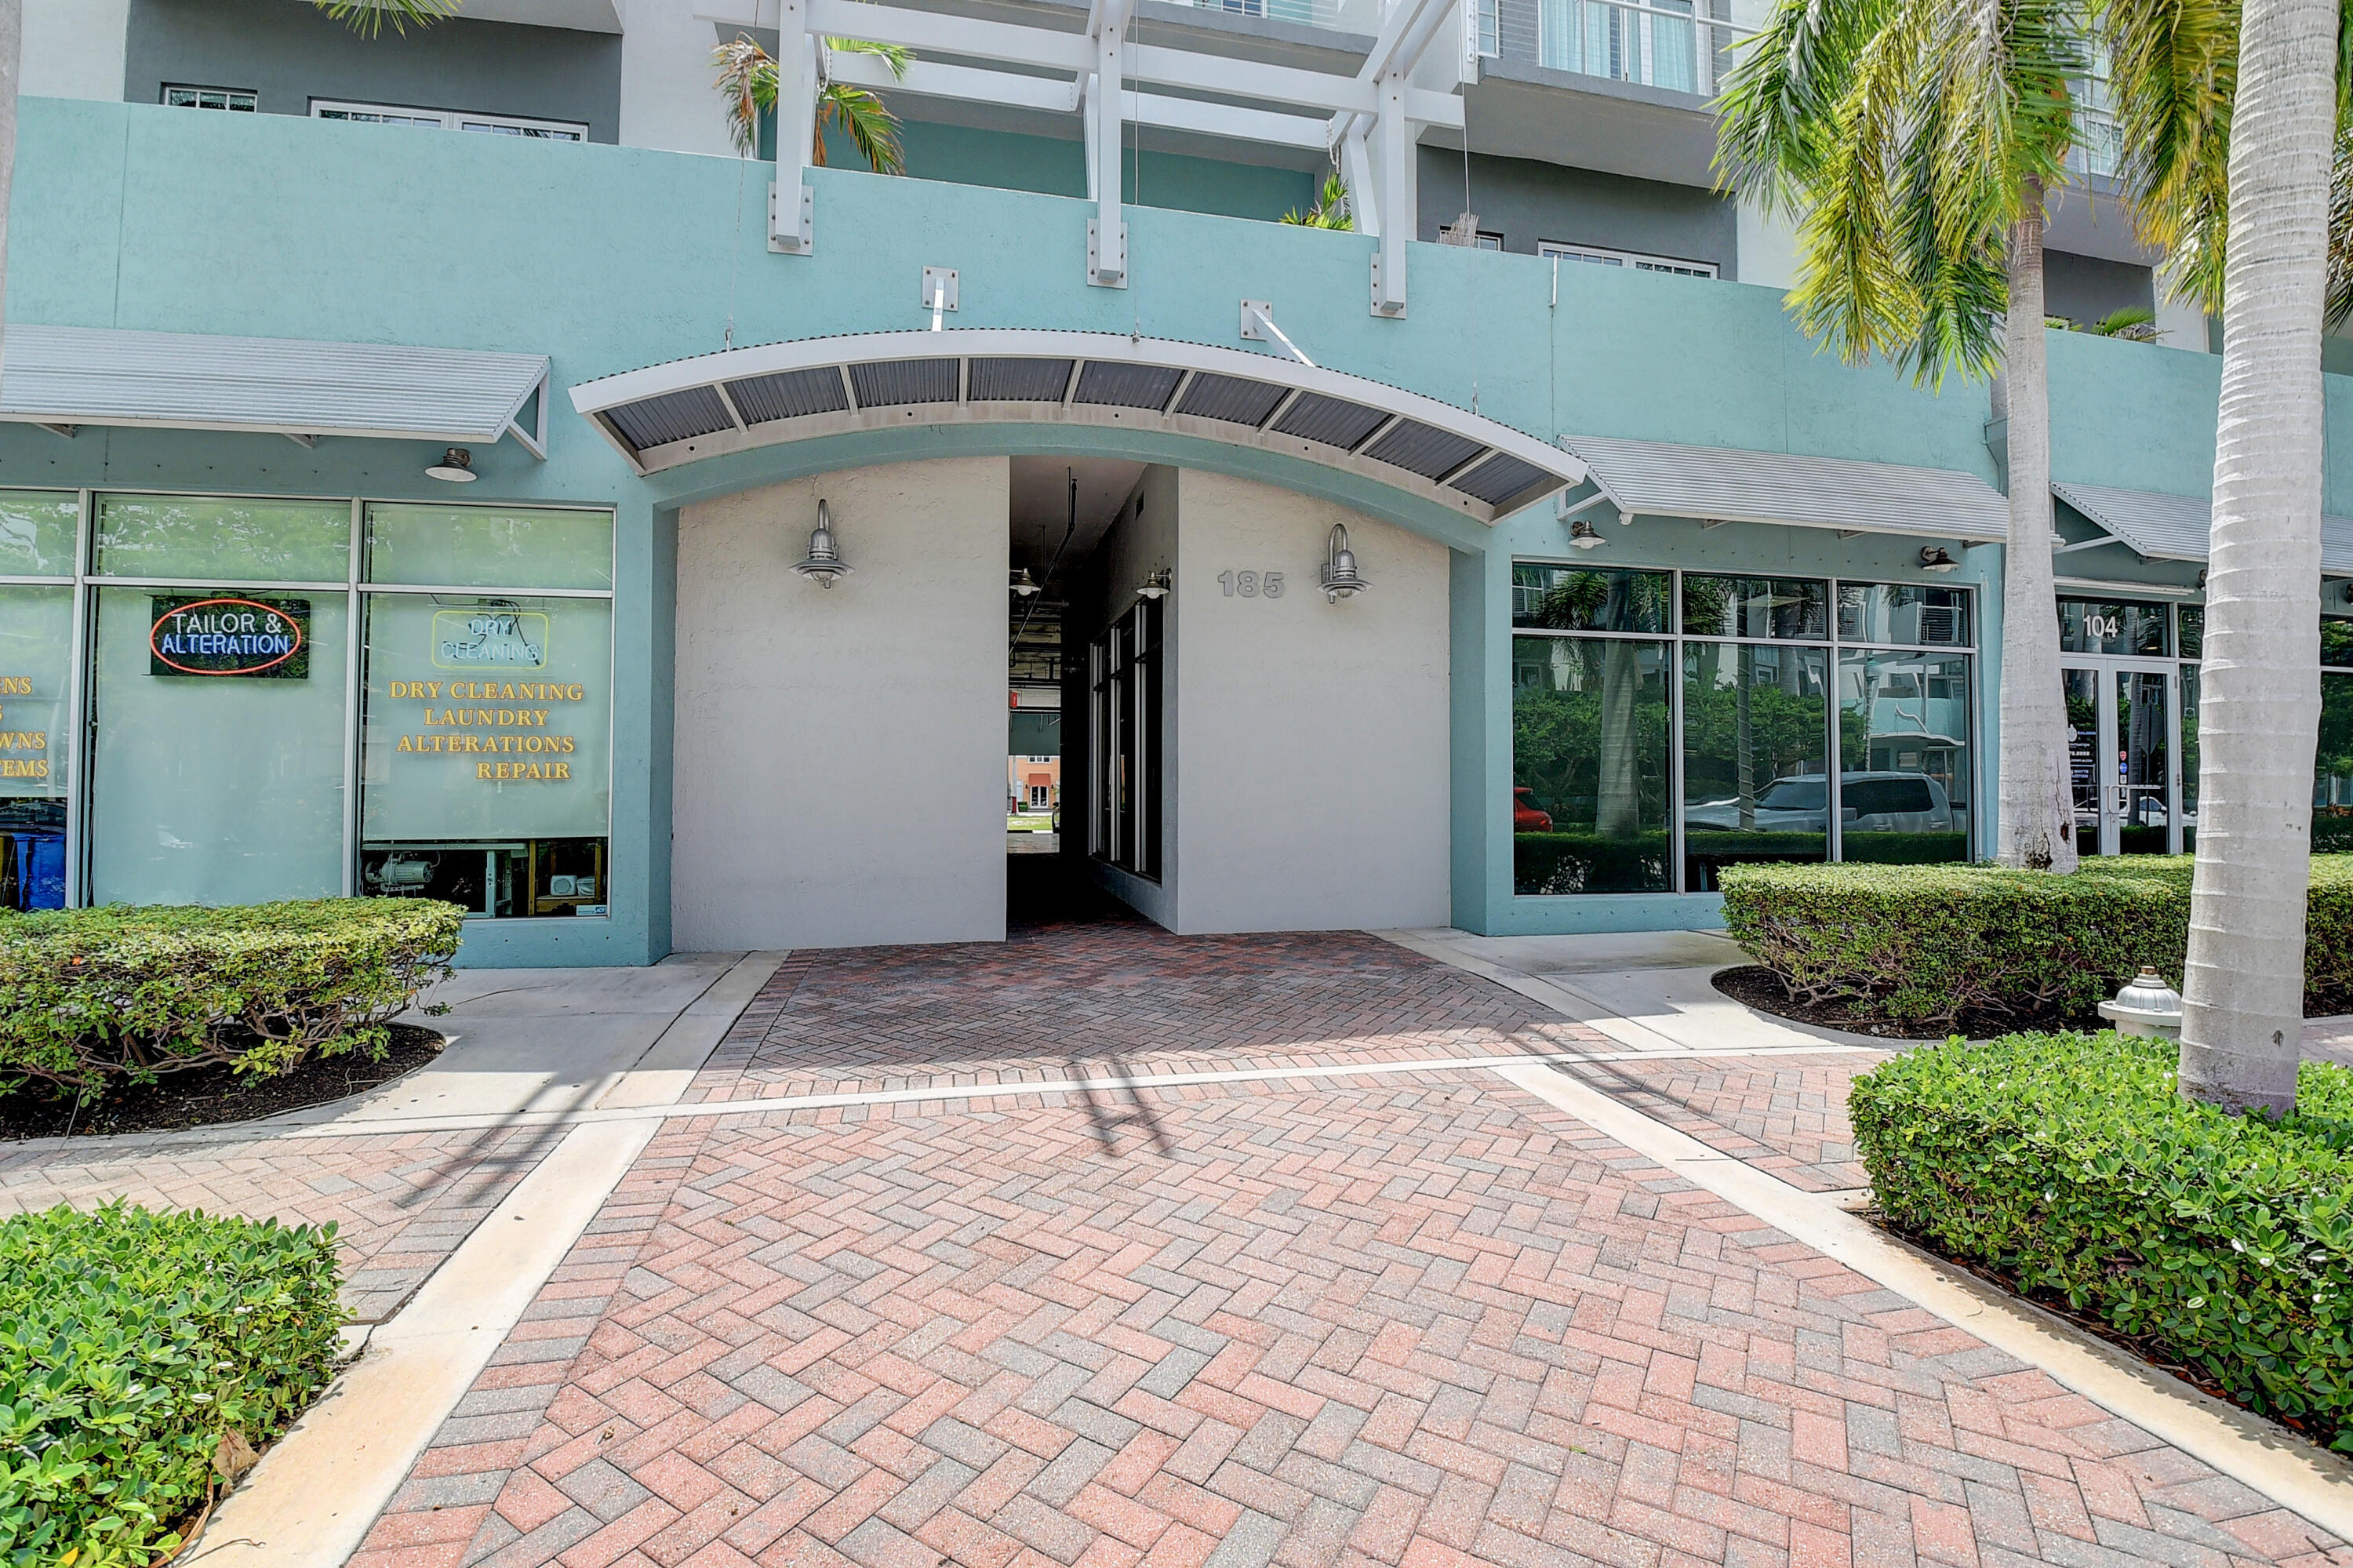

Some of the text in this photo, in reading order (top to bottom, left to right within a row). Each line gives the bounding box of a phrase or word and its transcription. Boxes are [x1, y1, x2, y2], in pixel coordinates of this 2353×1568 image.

[1217, 569, 1286, 598] 185
[170, 613, 282, 634] TAILOR &
[471, 619, 512, 636] DRY
[2083, 614, 2118, 638] 104
[161, 634, 289, 654] ALTERATION
[441, 642, 540, 661] CLEANING
[0, 676, 33, 695] NS
[389, 681, 584, 701] DRY CLEANING
[424, 708, 550, 726] LAUNDRY
[395, 734, 575, 753] ALTERATIONS
[0, 759, 49, 777] EMS
[475, 762, 572, 779] REPAIR
